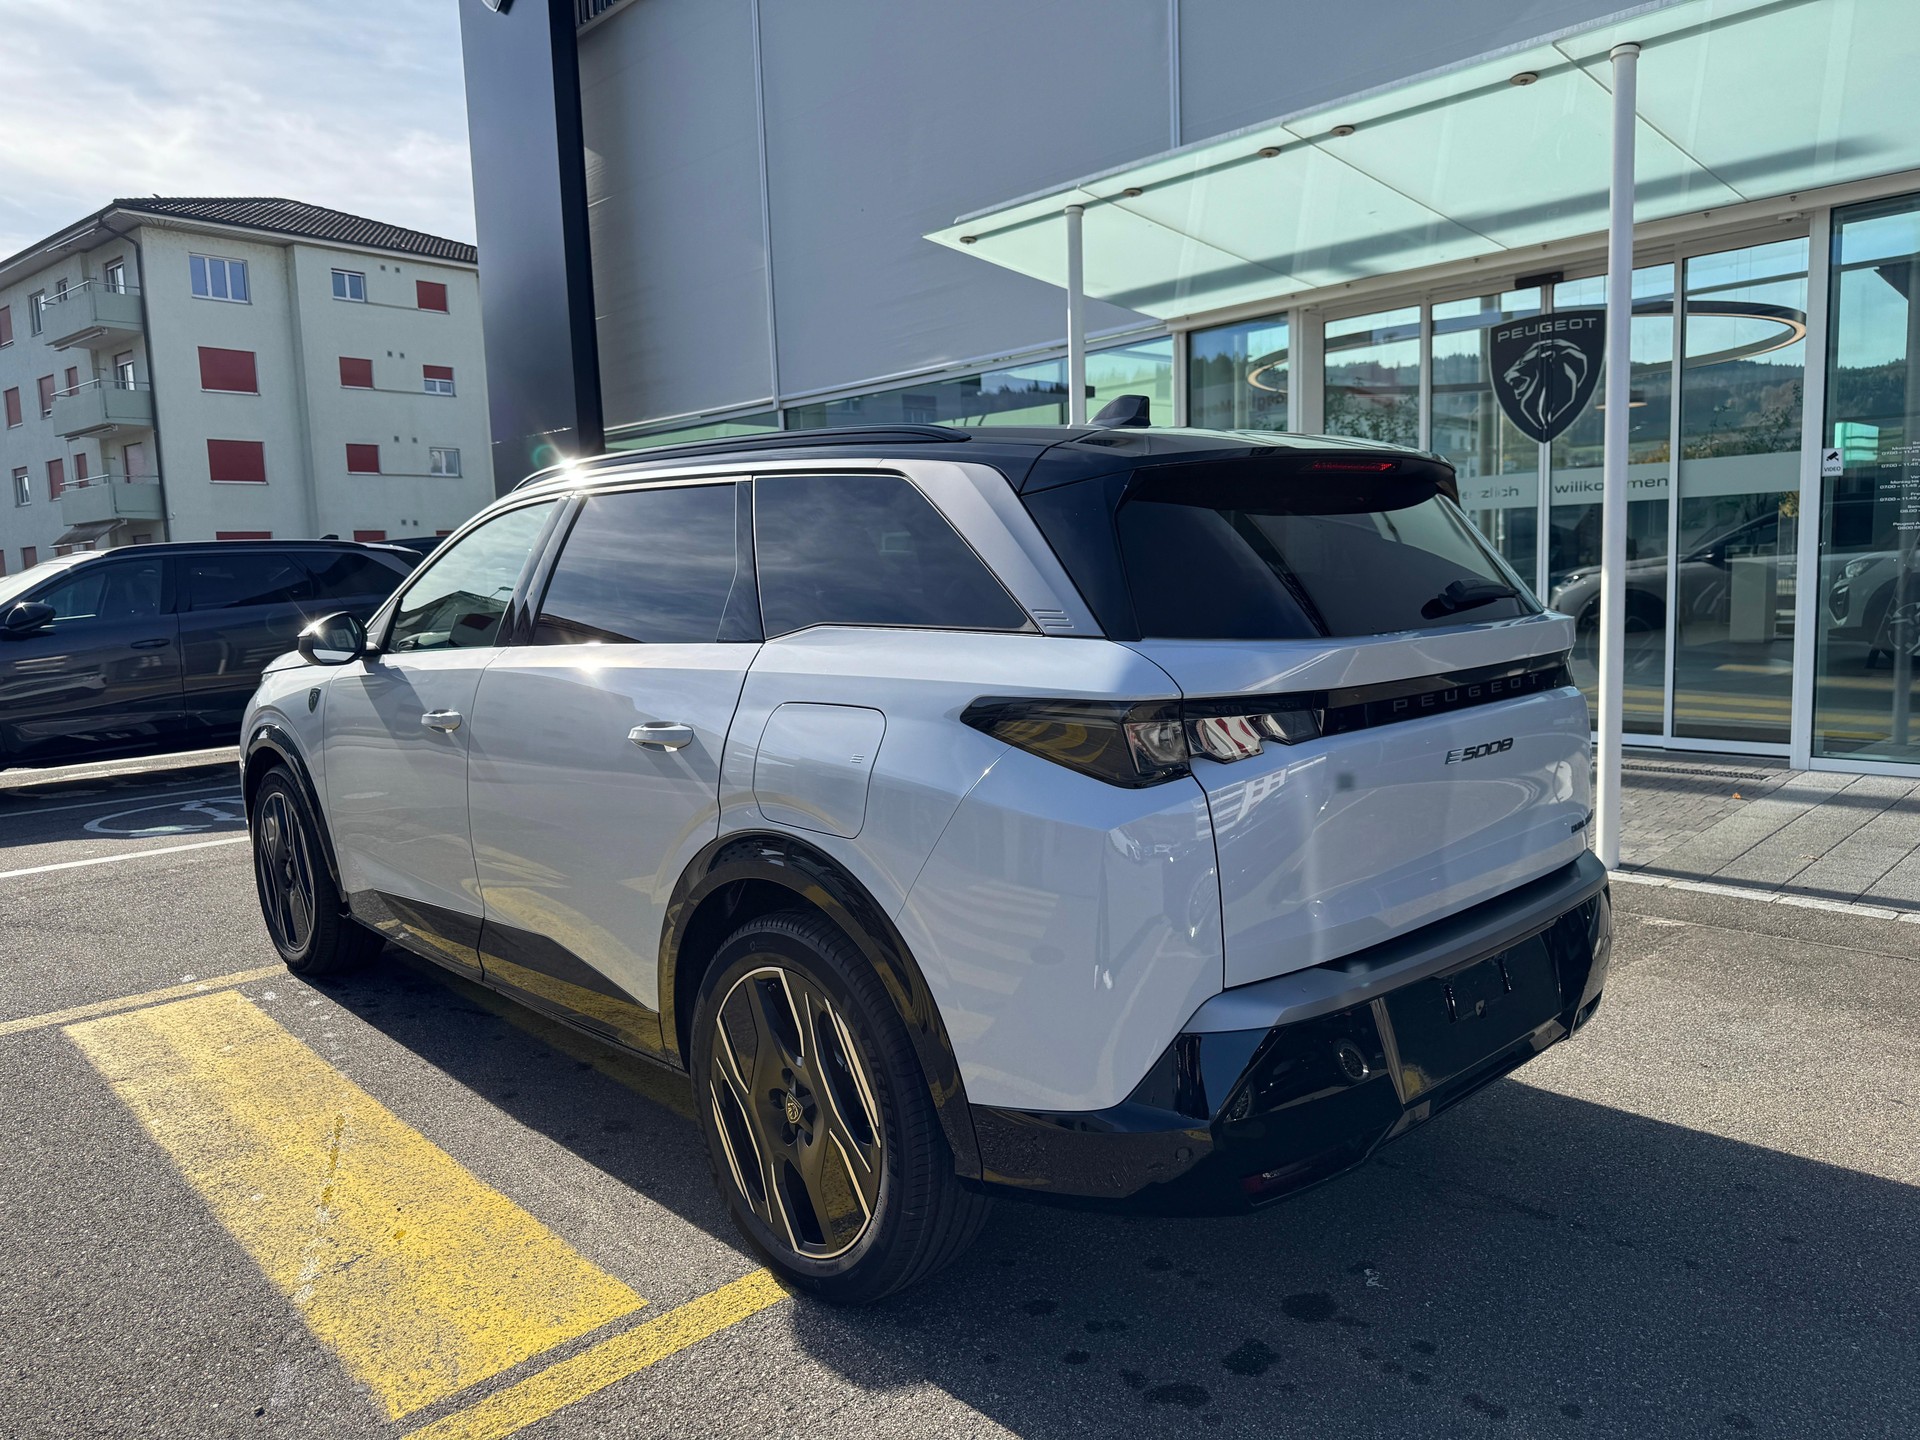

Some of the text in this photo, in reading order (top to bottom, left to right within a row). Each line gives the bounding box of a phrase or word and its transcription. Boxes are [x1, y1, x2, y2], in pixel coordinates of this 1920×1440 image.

[1497, 318, 1597, 343] PEUGEOT
[1554, 476, 1669, 494] willkomen
[1393, 673, 1539, 712] PEUGEOT
